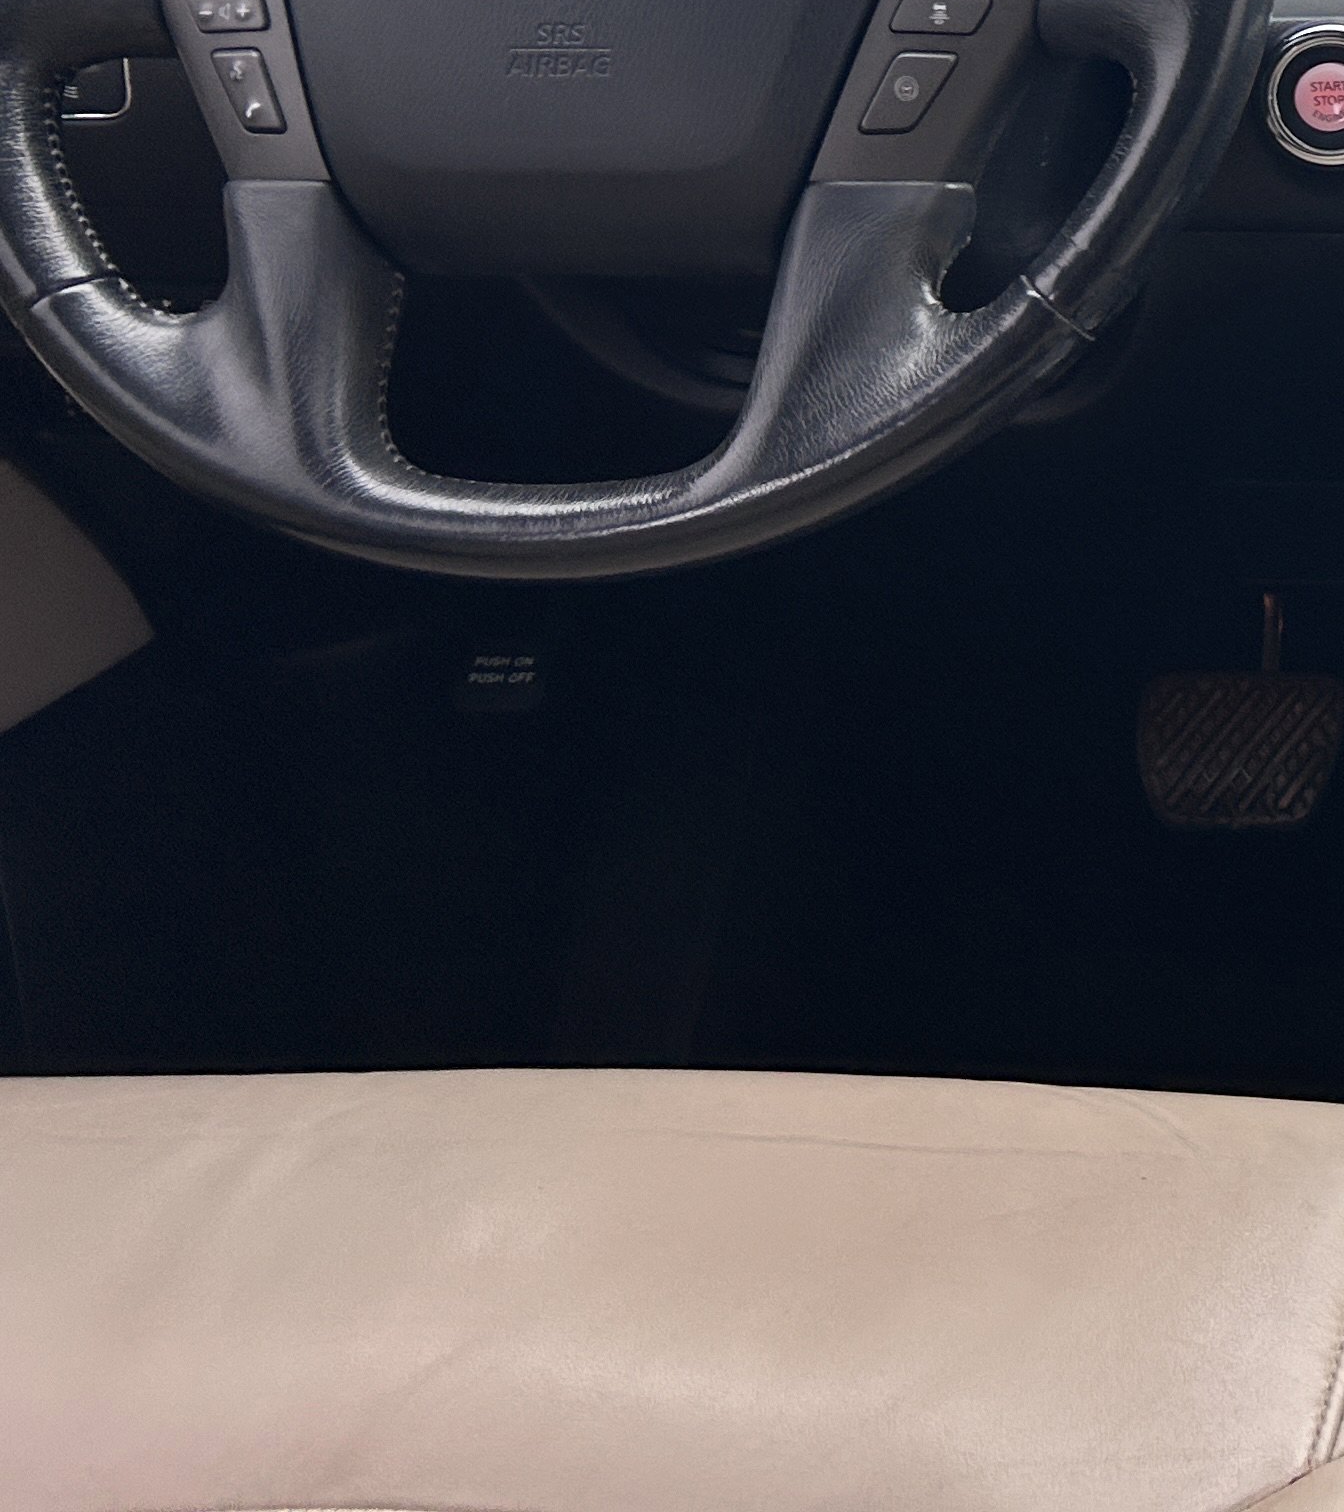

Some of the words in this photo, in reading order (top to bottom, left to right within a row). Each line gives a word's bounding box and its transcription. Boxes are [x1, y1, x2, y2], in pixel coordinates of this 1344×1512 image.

[537, 22, 586, 45] SRS
[506, 55, 612, 78] AIRBAG
[474, 656, 511, 666] PUSH
[468, 672, 505, 683] PUSH
[508, 672, 536, 683] OFF
